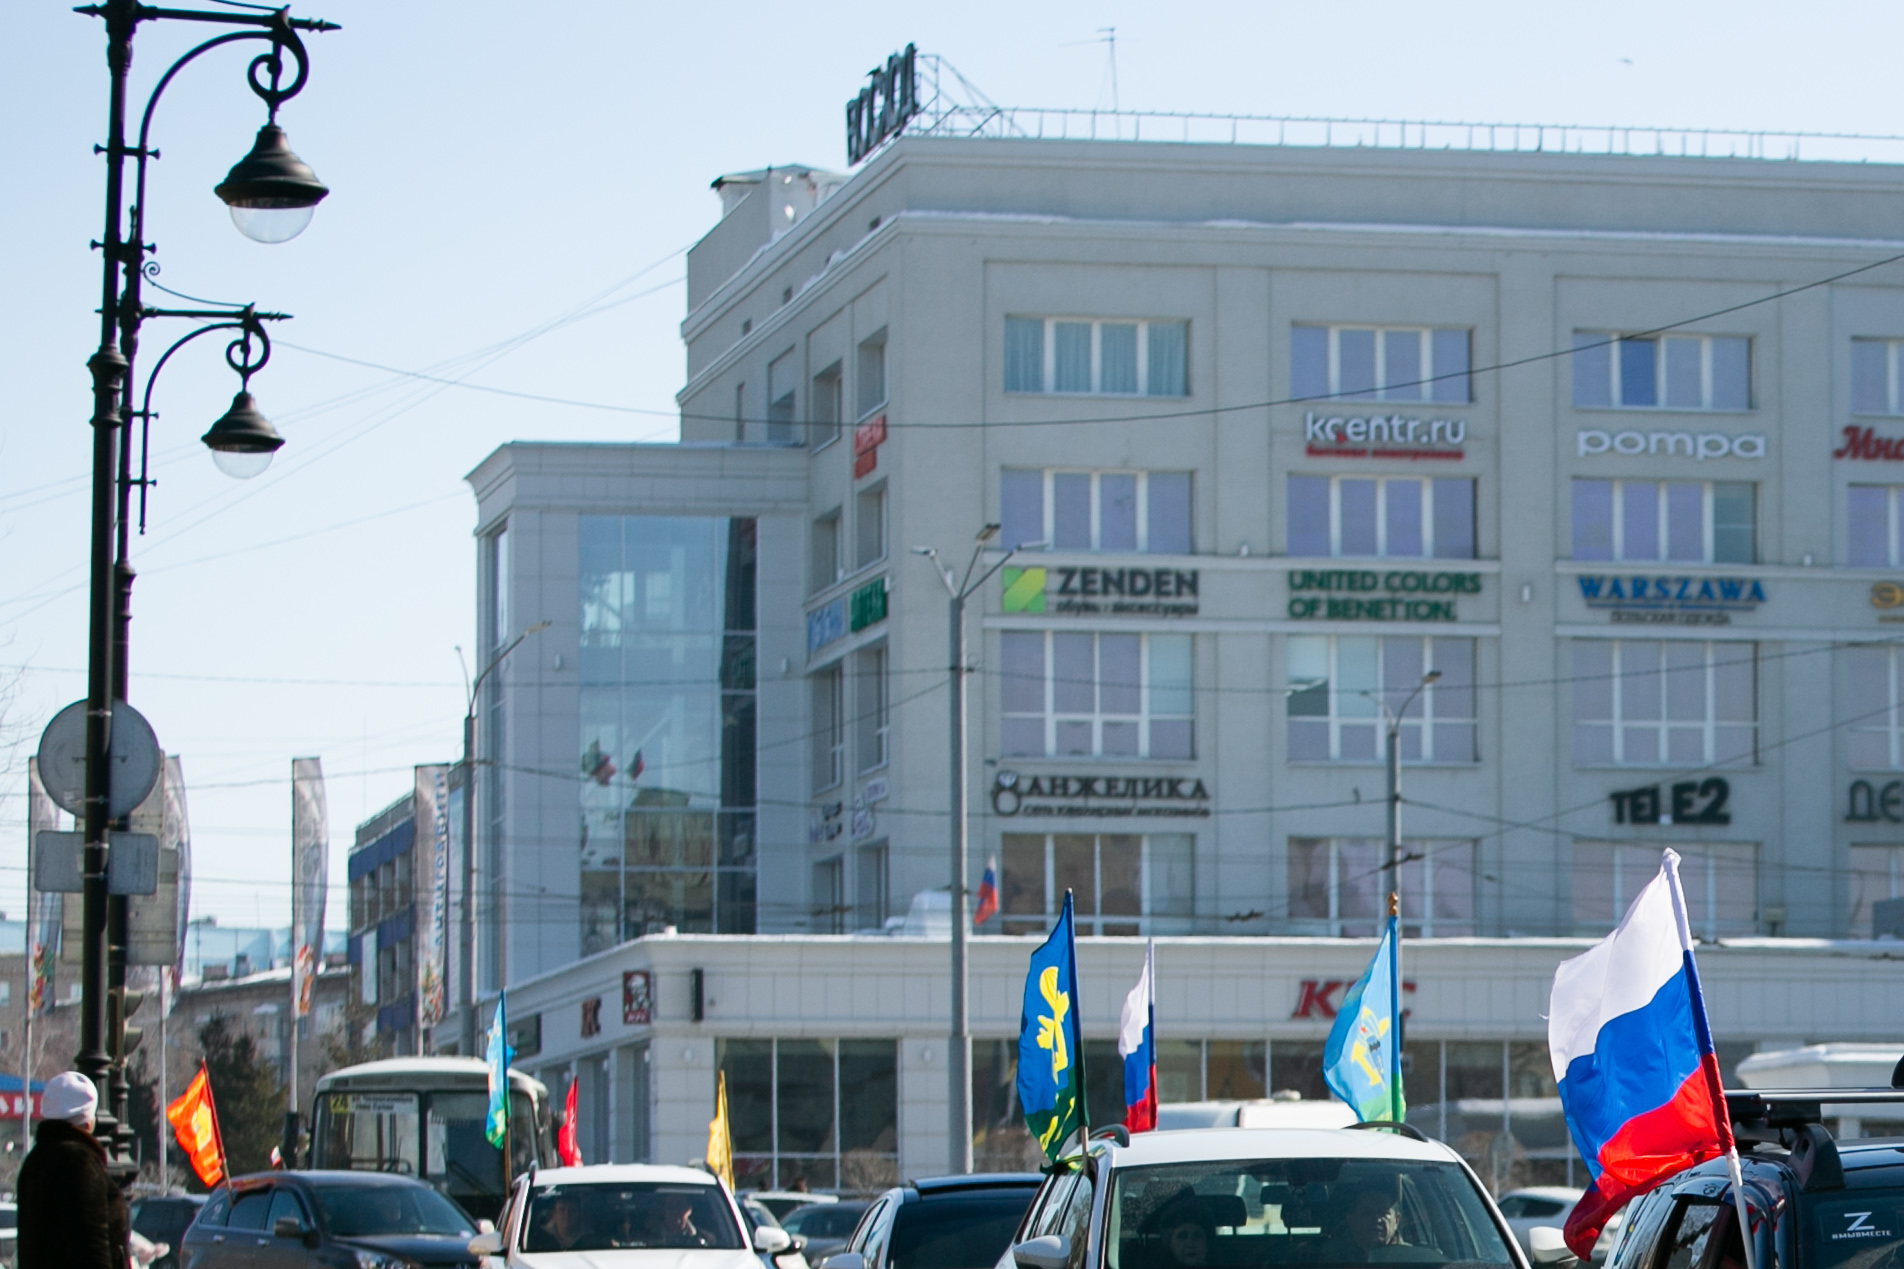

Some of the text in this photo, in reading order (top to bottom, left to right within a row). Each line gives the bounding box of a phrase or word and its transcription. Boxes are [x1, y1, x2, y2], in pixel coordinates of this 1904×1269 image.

[1305, 410, 1465, 444] kcentr.ru
[1577, 430, 1766, 461] pompa
[1058, 567, 1199, 597] ZENDEN
[1289, 570, 1482, 593] UNITED COLORS
[1578, 576, 1767, 603] WARSZAWA
[1288, 598, 1320, 618] OF
[1027, 776, 1210, 800] АНЖЕЛИКА
[1610, 776, 1731, 825] TELE2
[1844, 1211, 1875, 1231] Z
